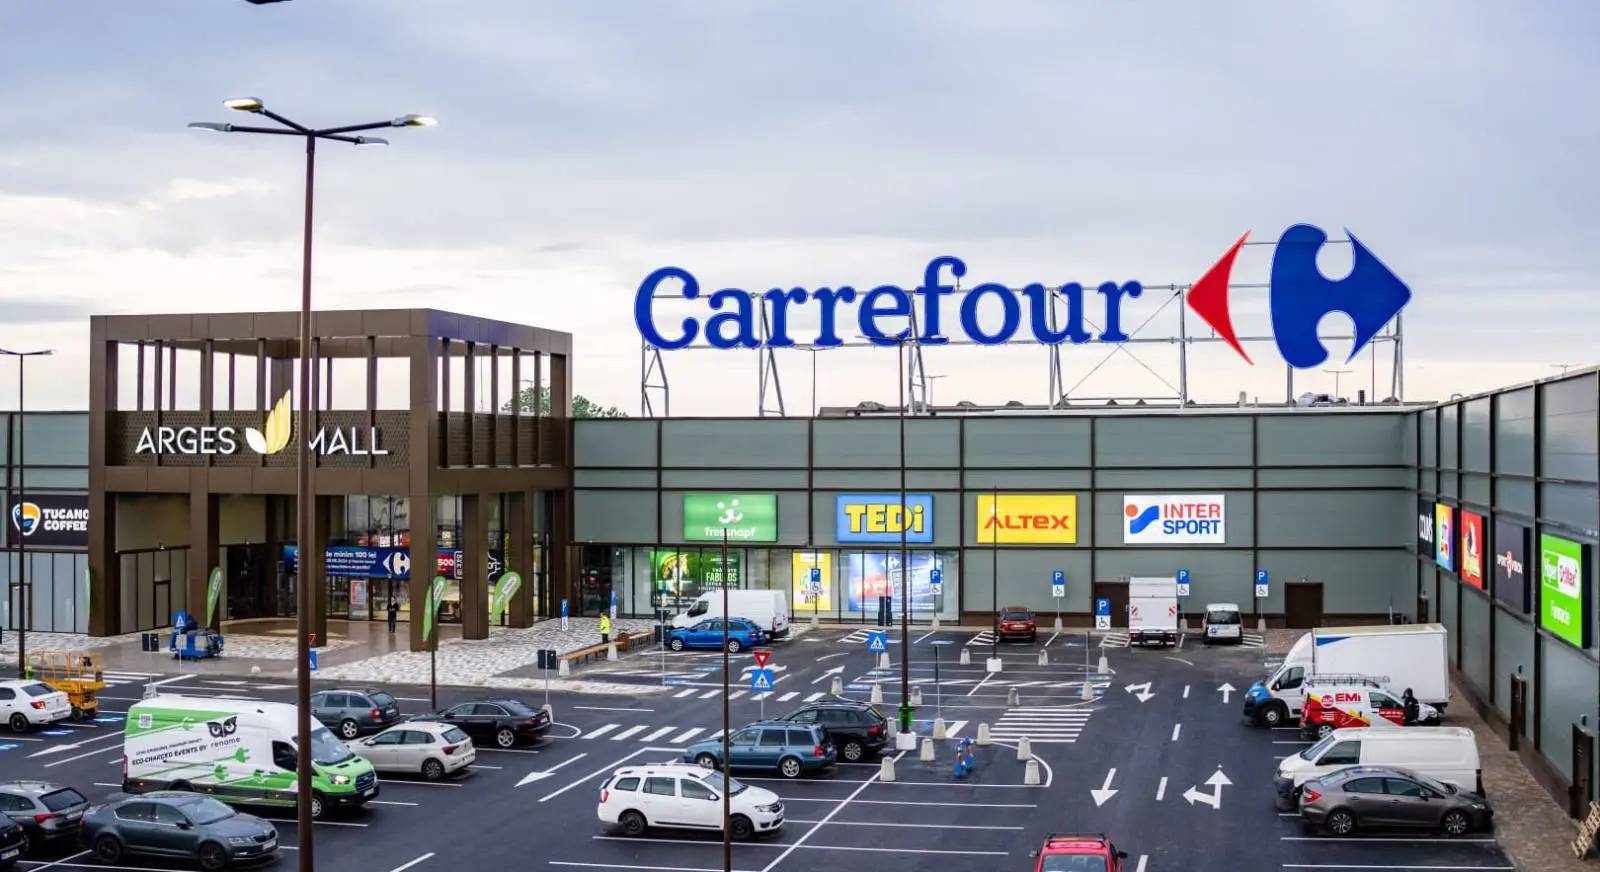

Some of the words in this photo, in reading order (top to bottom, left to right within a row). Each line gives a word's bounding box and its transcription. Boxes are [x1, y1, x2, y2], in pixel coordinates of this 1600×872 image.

[633, 255, 1144, 351] Carrefour
[135, 426, 236, 455] ARGES
[1163, 503, 1221, 519] INTER
[845, 504, 924, 533] TEDi
[43, 520, 87, 531] COFFEE
[1163, 519, 1221, 535] SPORT
[706, 571, 737, 582] FABUOS
[1055, 572, 1062, 581] P
[1180, 571, 1186, 581] P
[1258, 571, 1265, 581] P
[1099, 600, 1107, 611] P
[210, 737, 241, 748] rename
[174, 747, 198, 757] EVENTS
